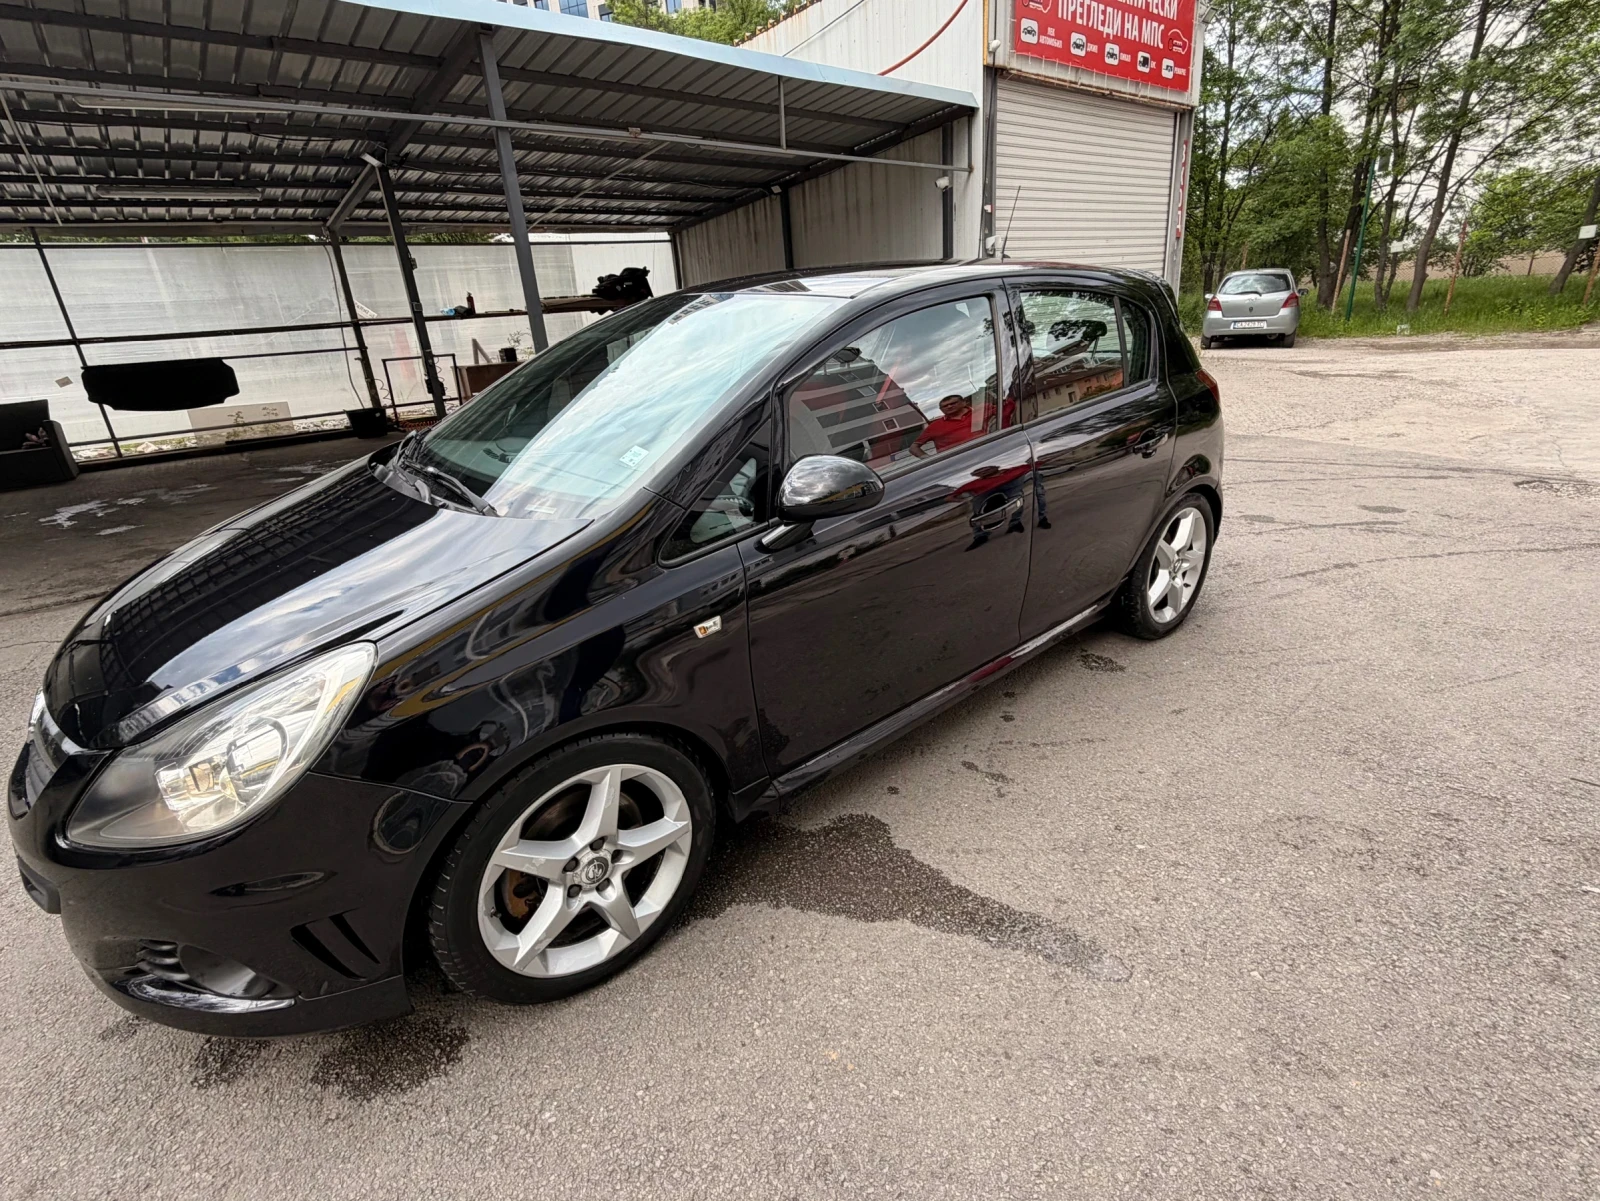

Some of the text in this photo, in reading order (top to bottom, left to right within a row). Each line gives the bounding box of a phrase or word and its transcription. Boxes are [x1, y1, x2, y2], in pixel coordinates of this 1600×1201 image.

[1058, 0, 1122, 39] ПРЕГЛЕДИ
[1124, 12, 1139, 41] НА
[1141, 18, 1165, 49] МПС
